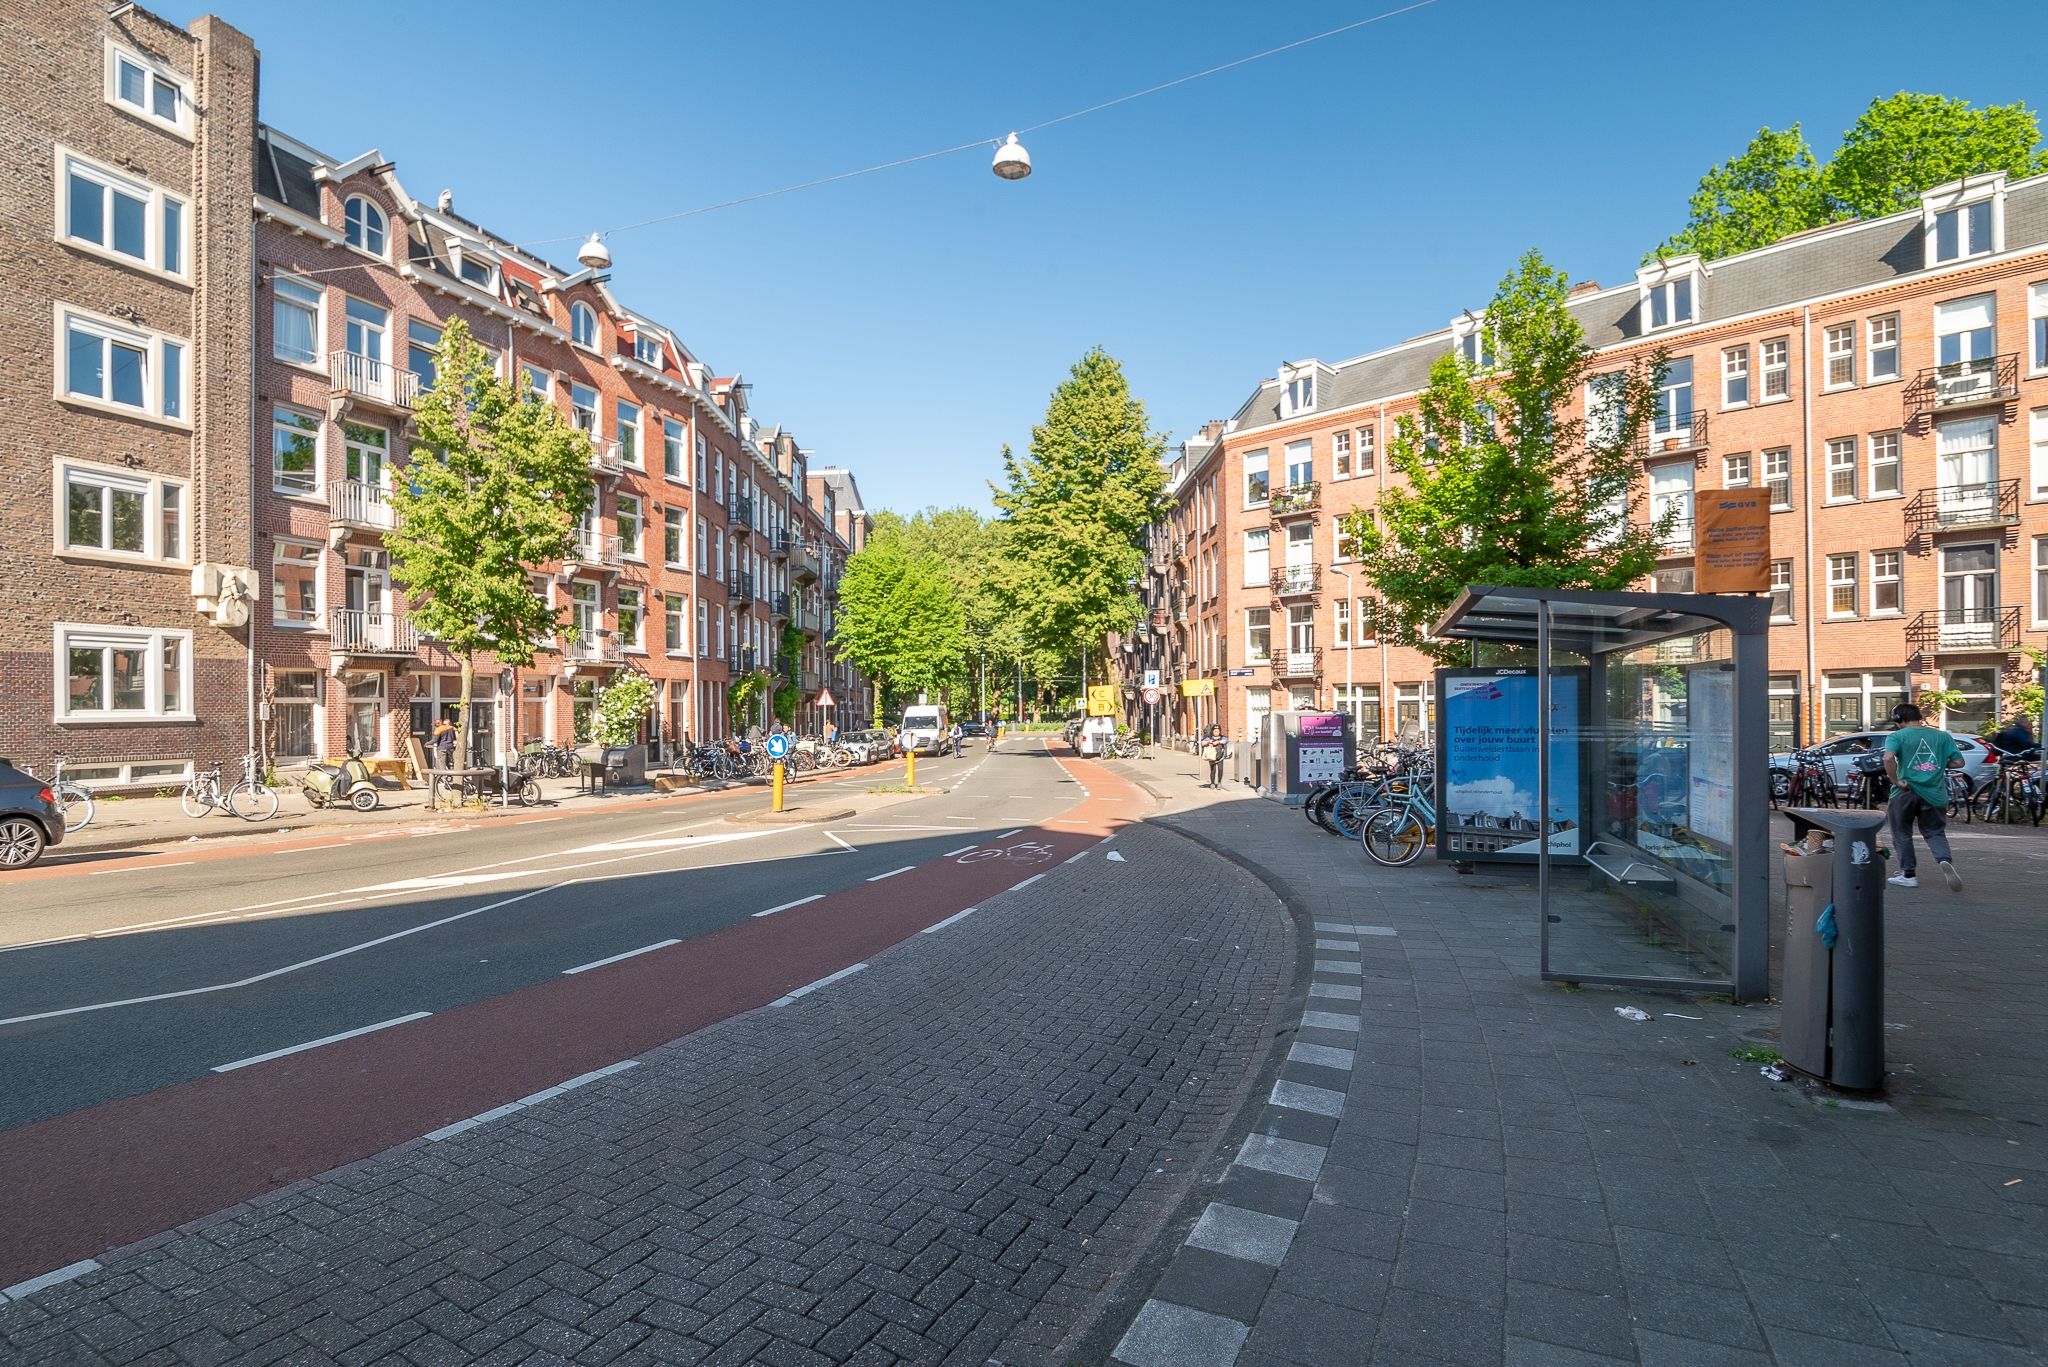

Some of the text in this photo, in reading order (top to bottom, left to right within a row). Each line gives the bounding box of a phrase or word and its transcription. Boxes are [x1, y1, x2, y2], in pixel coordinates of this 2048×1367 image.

[1454, 726, 1493, 736] Tijdelijk
[1478, 735, 1504, 745] jouw
[1506, 735, 1536, 744] buurt
[1454, 745, 1530, 753] Buitenveldertbaan
[1454, 753, 1500, 761] onderhoud
